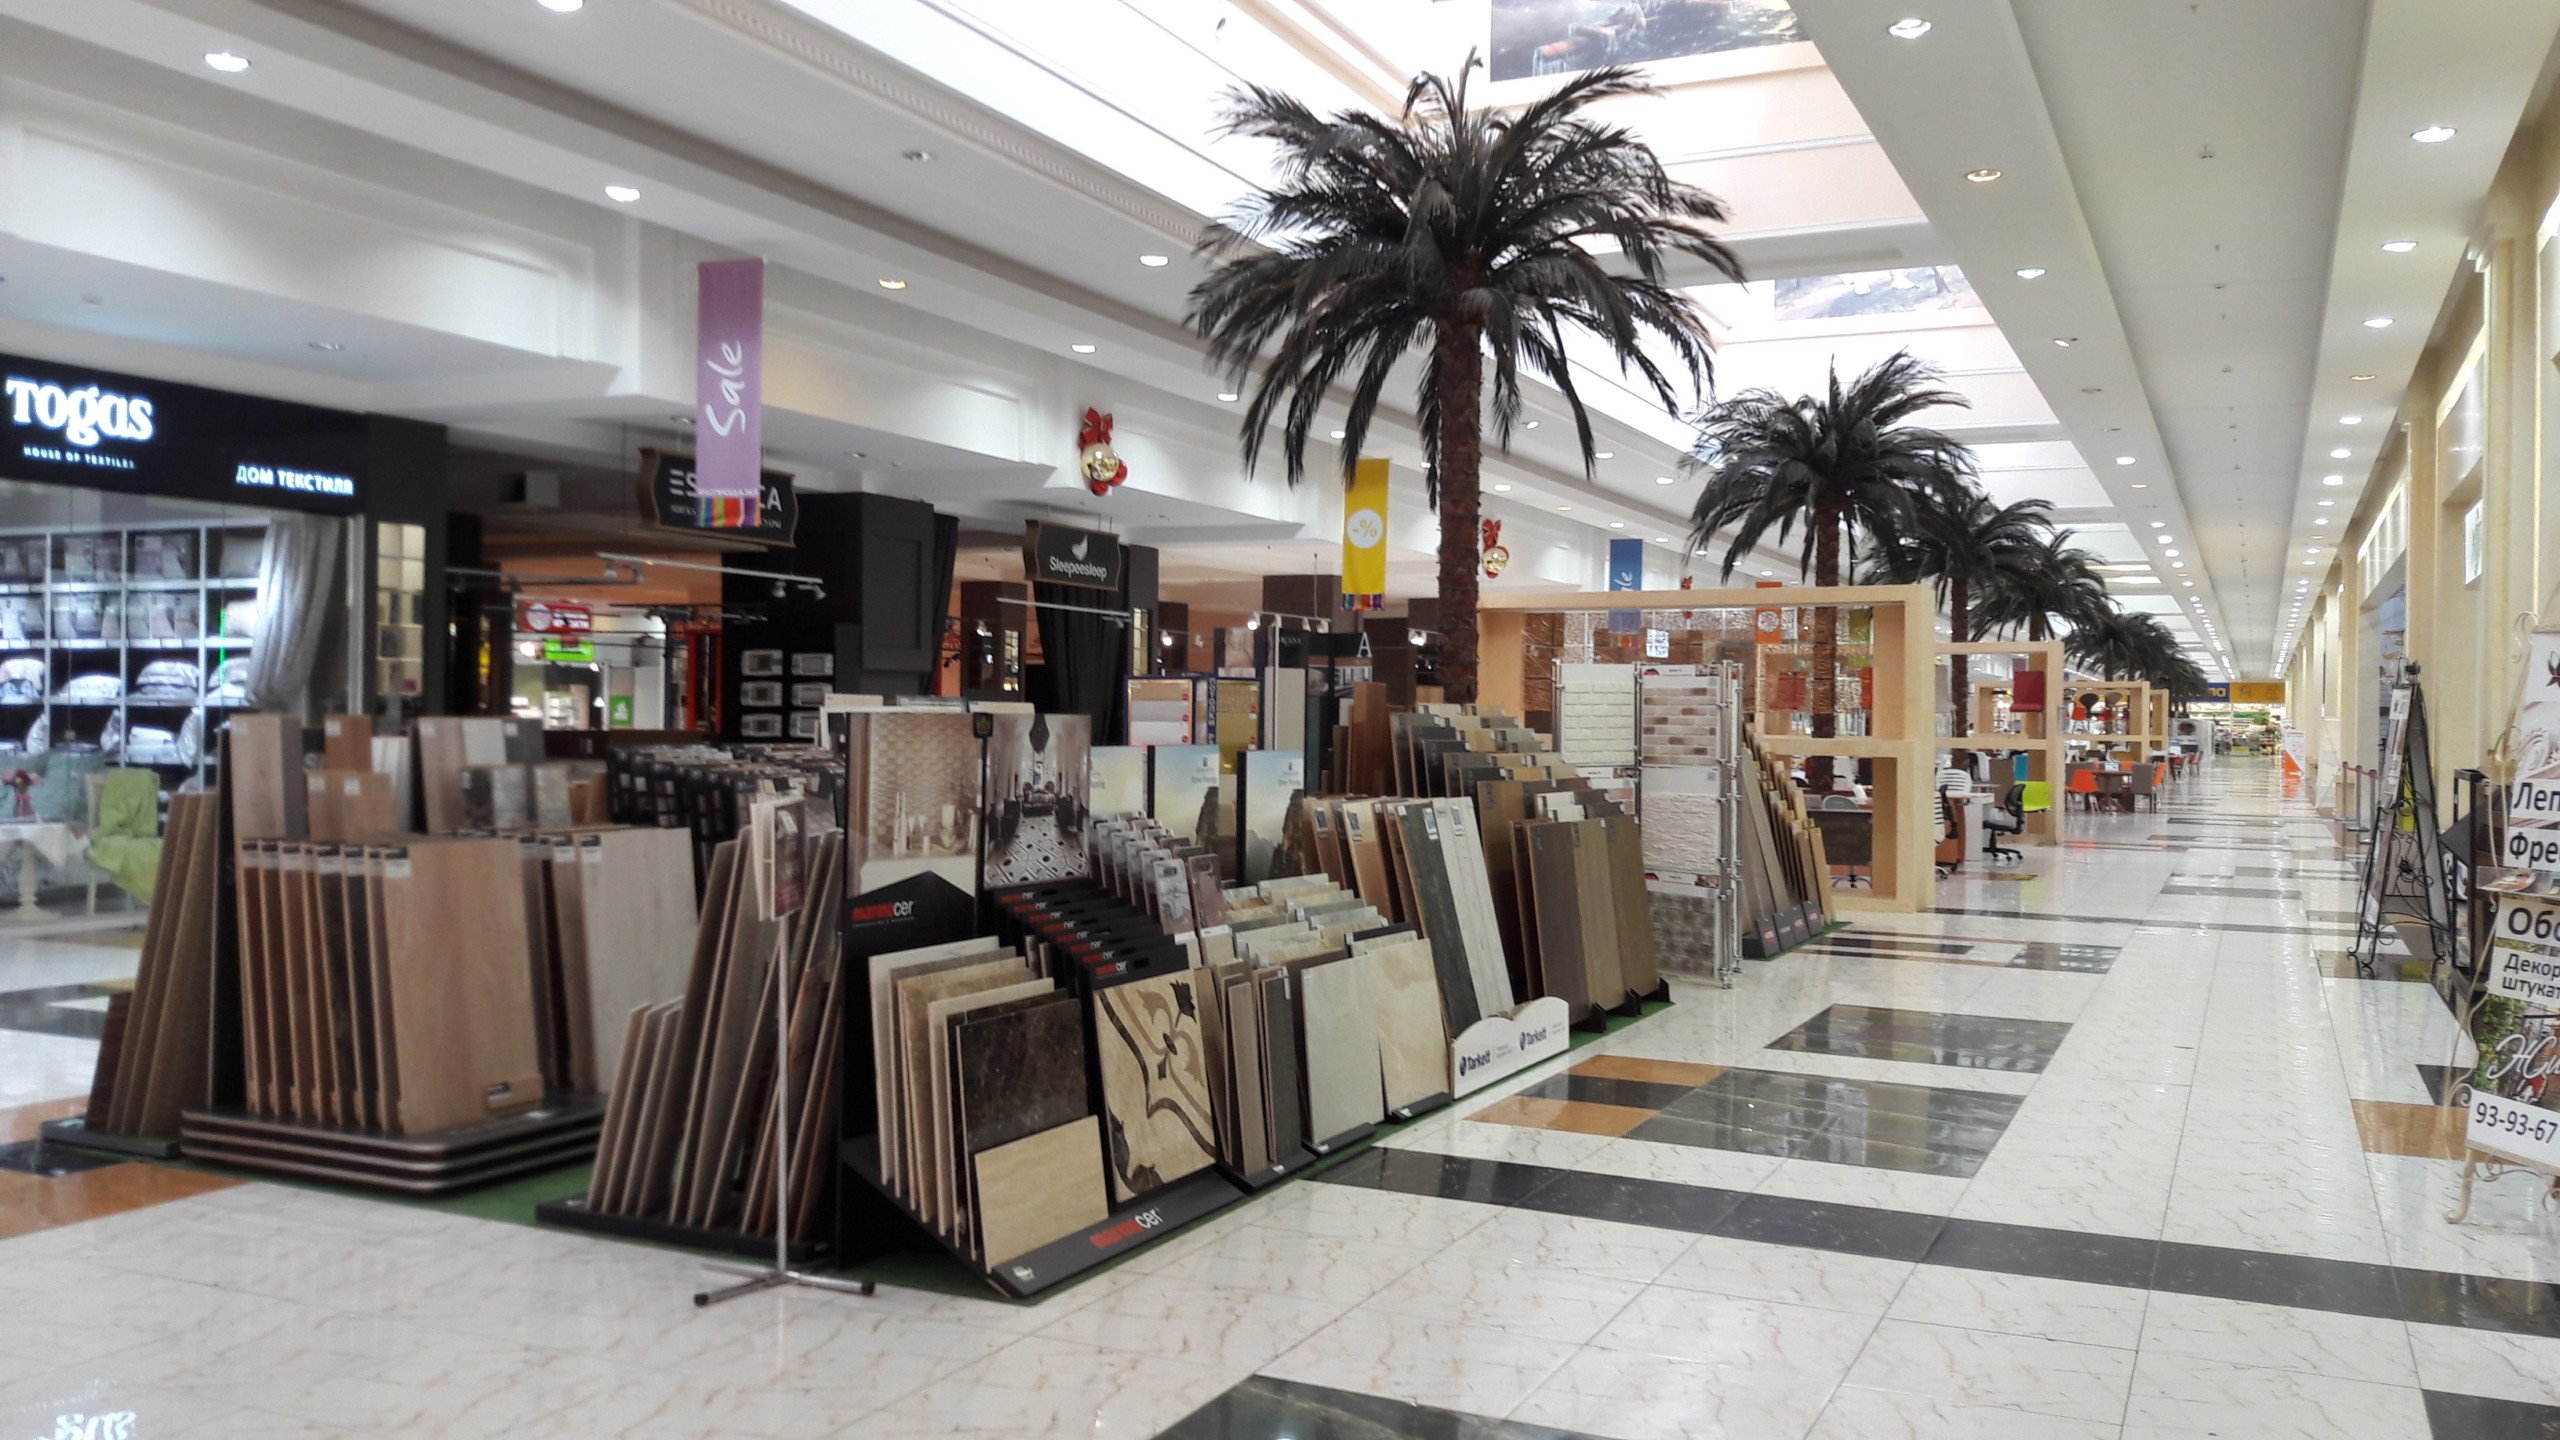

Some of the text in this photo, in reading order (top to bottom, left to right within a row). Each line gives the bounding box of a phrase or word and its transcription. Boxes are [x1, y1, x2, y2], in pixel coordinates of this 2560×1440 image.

[705, 340, 745, 437] Sale
[6, 378, 154, 446] Togas
[23, 445, 62, 461] HOUSE
[65, 451, 81, 462] OF
[236, 464, 354, 496] ДОМ ТЕКСТИЛЯ
[1049, 555, 1108, 582] Sleepeesleep
[2509, 831, 2560, 868] Фре
[2475, 1101, 2559, 1144] 93-93-67
